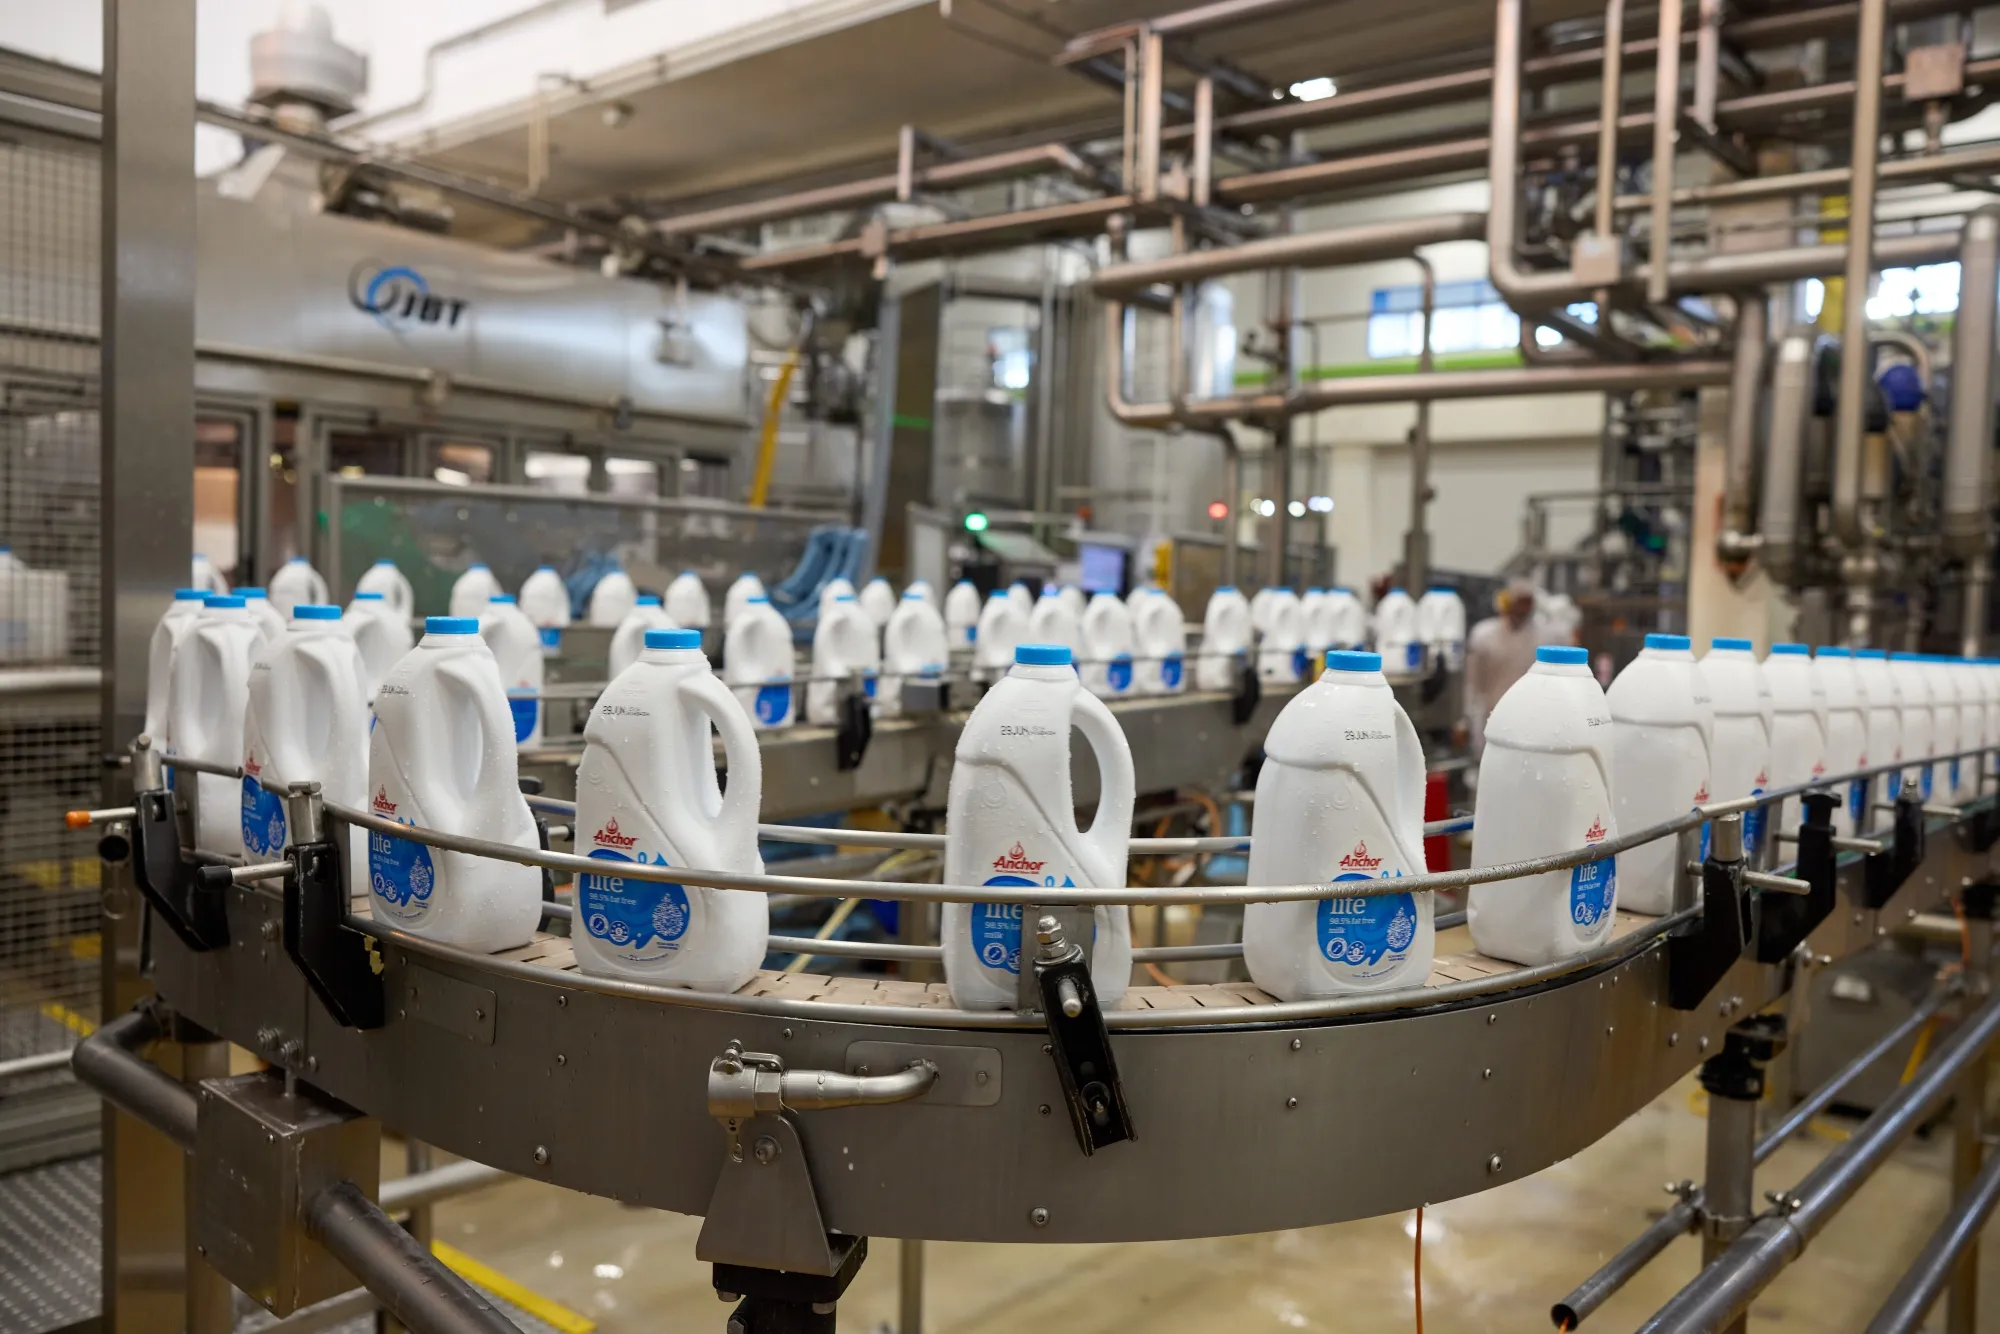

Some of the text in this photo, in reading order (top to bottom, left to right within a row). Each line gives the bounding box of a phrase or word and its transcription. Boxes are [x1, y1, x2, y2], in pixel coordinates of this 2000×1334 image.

[400, 291, 470, 328] JBT
[373, 796, 398, 811] Anchor
[593, 830, 639, 846] Anchor
[1585, 827, 1607, 839] Anchor
[372, 831, 392, 855] lite
[992, 856, 1048, 871] Anchor
[1339, 854, 1385, 867] Anchor
[1579, 864, 1598, 883] lite
[588, 873, 624, 893] lite
[1330, 898, 1366, 915] lite
